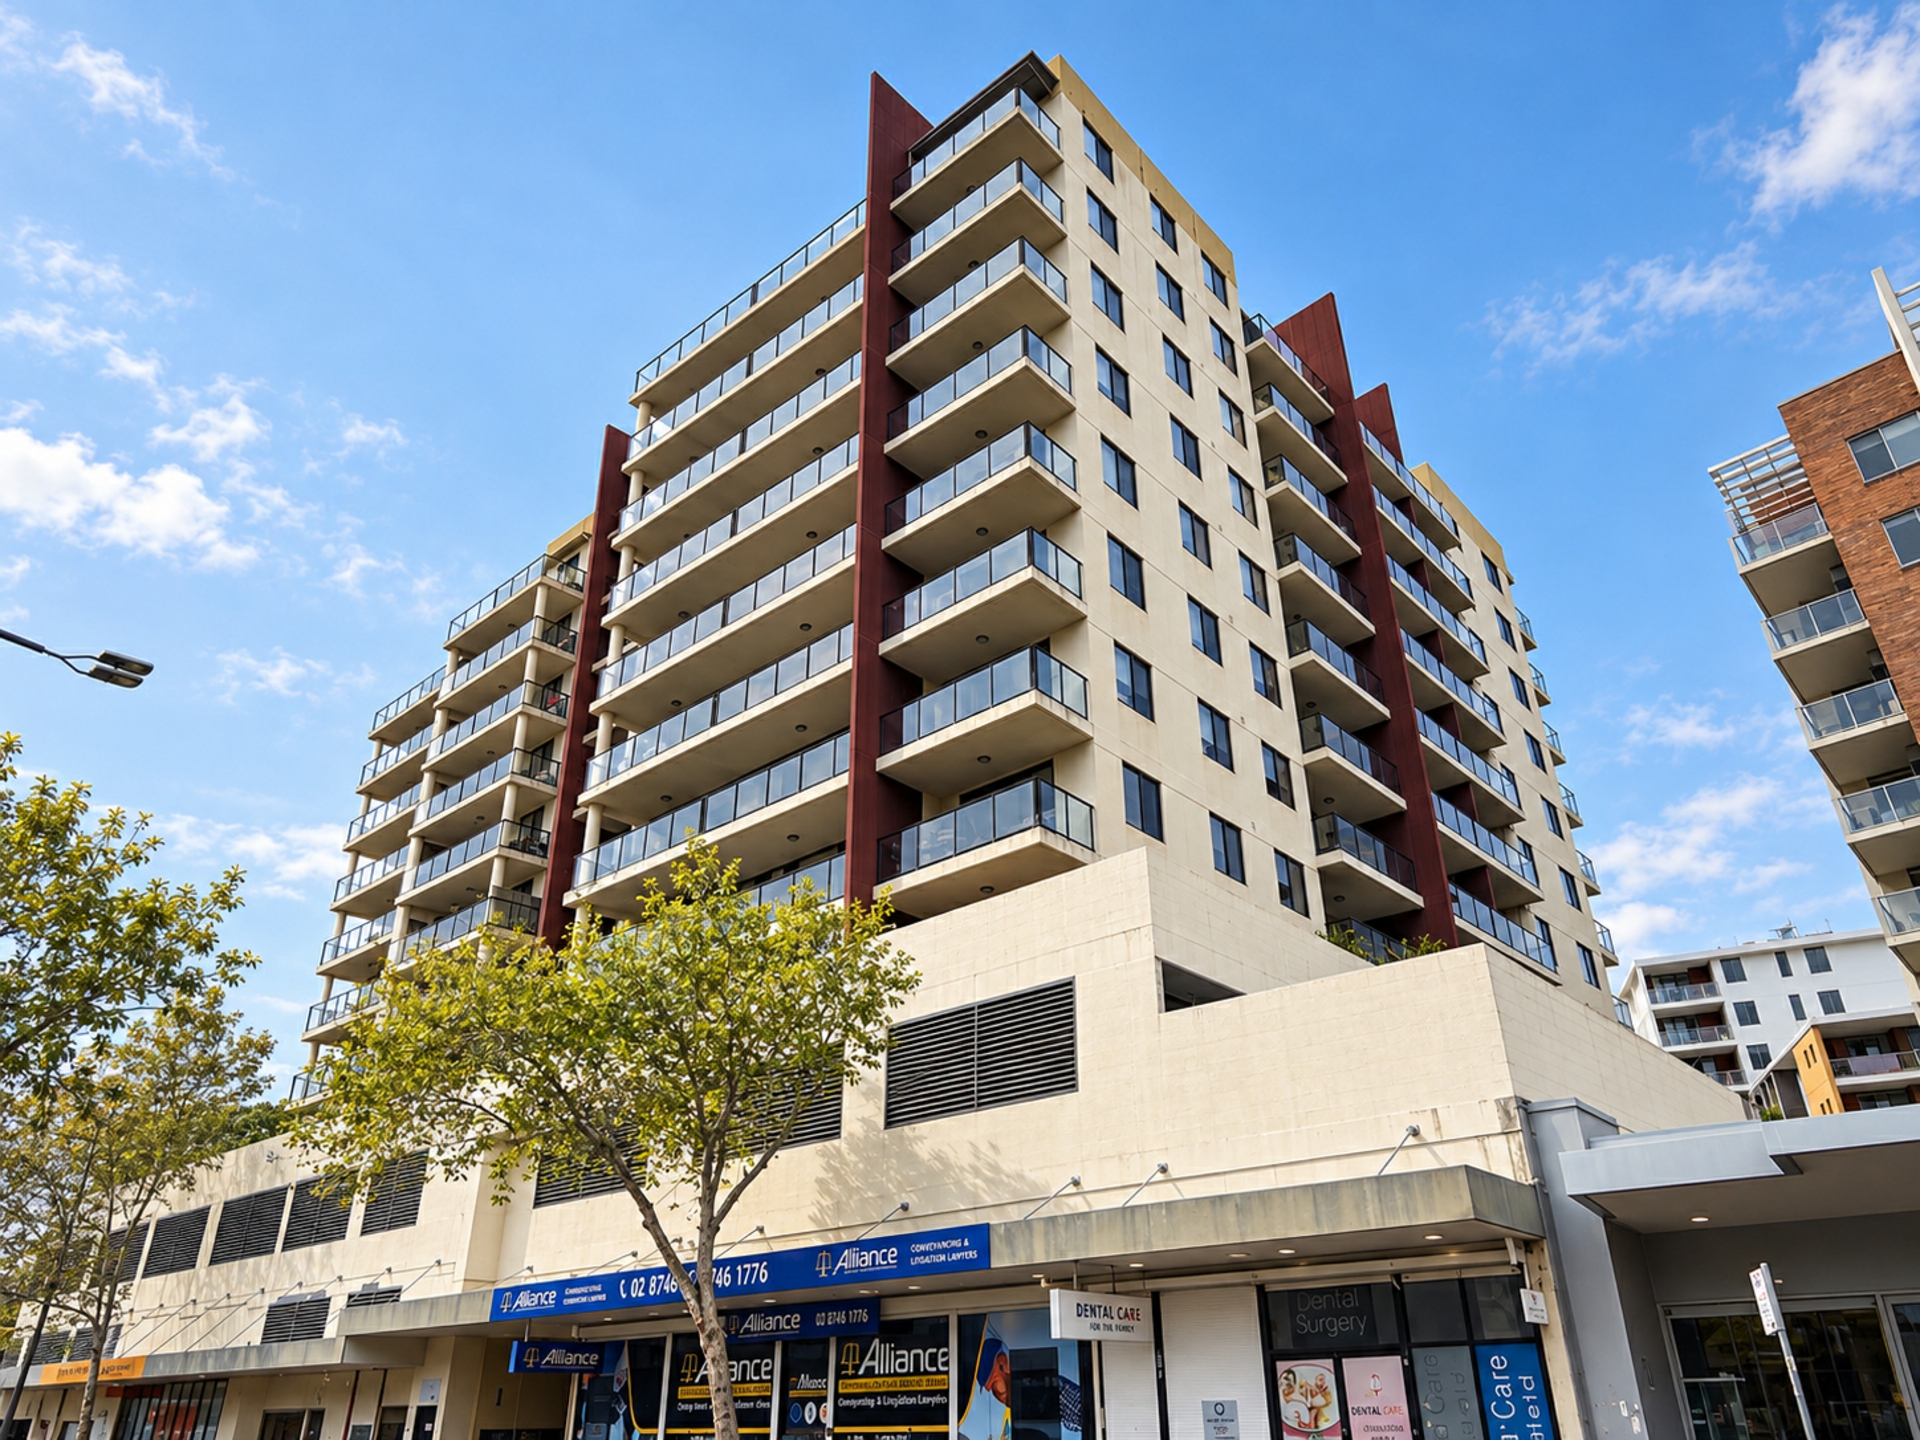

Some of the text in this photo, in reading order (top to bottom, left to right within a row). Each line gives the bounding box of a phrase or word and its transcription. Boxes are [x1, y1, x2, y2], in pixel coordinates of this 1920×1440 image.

[832, 1247, 898, 1276] Alliance
[630, 1276, 645, 1298] 02
[736, 1261, 768, 1286] 1776
[510, 1290, 557, 1312] Alliance
[1297, 1287, 1359, 1312] Dental
[739, 1313, 800, 1334] Alliance
[1076, 1303, 1141, 1322] DENTAL CARE
[1296, 1313, 1367, 1338] Surgery
[541, 1348, 599, 1365] Alliance
[858, 1338, 950, 1375] Alliance
[1490, 1355, 1516, 1419] Care
[1351, 1406, 1382, 1416] DENTAL
